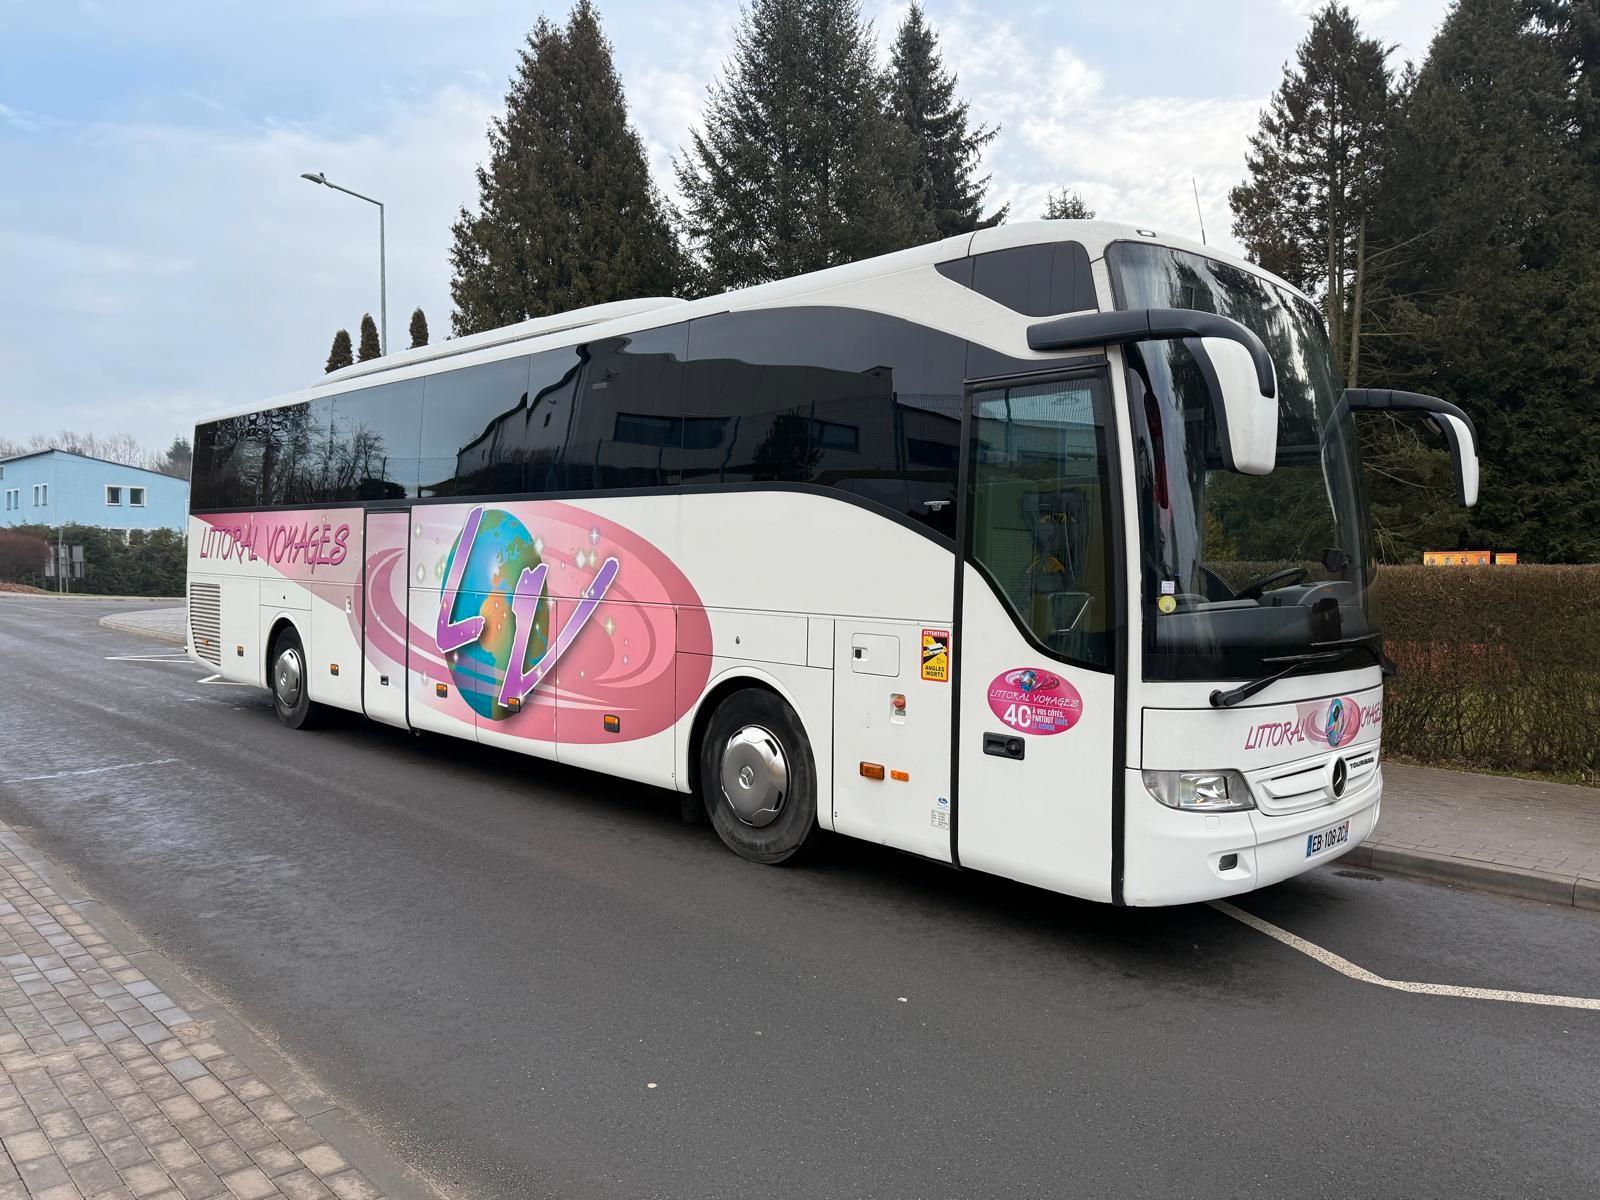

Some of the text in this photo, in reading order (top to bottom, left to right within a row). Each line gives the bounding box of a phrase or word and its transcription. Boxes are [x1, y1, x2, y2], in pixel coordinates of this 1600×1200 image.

[200, 520, 350, 574] LITTORAL VOYAGES
[990, 689, 1079, 708] LITTORAL VOYAGES
[1032, 714, 1054, 724] PARTOUT
[1244, 718, 1305, 750] LITTORAL
